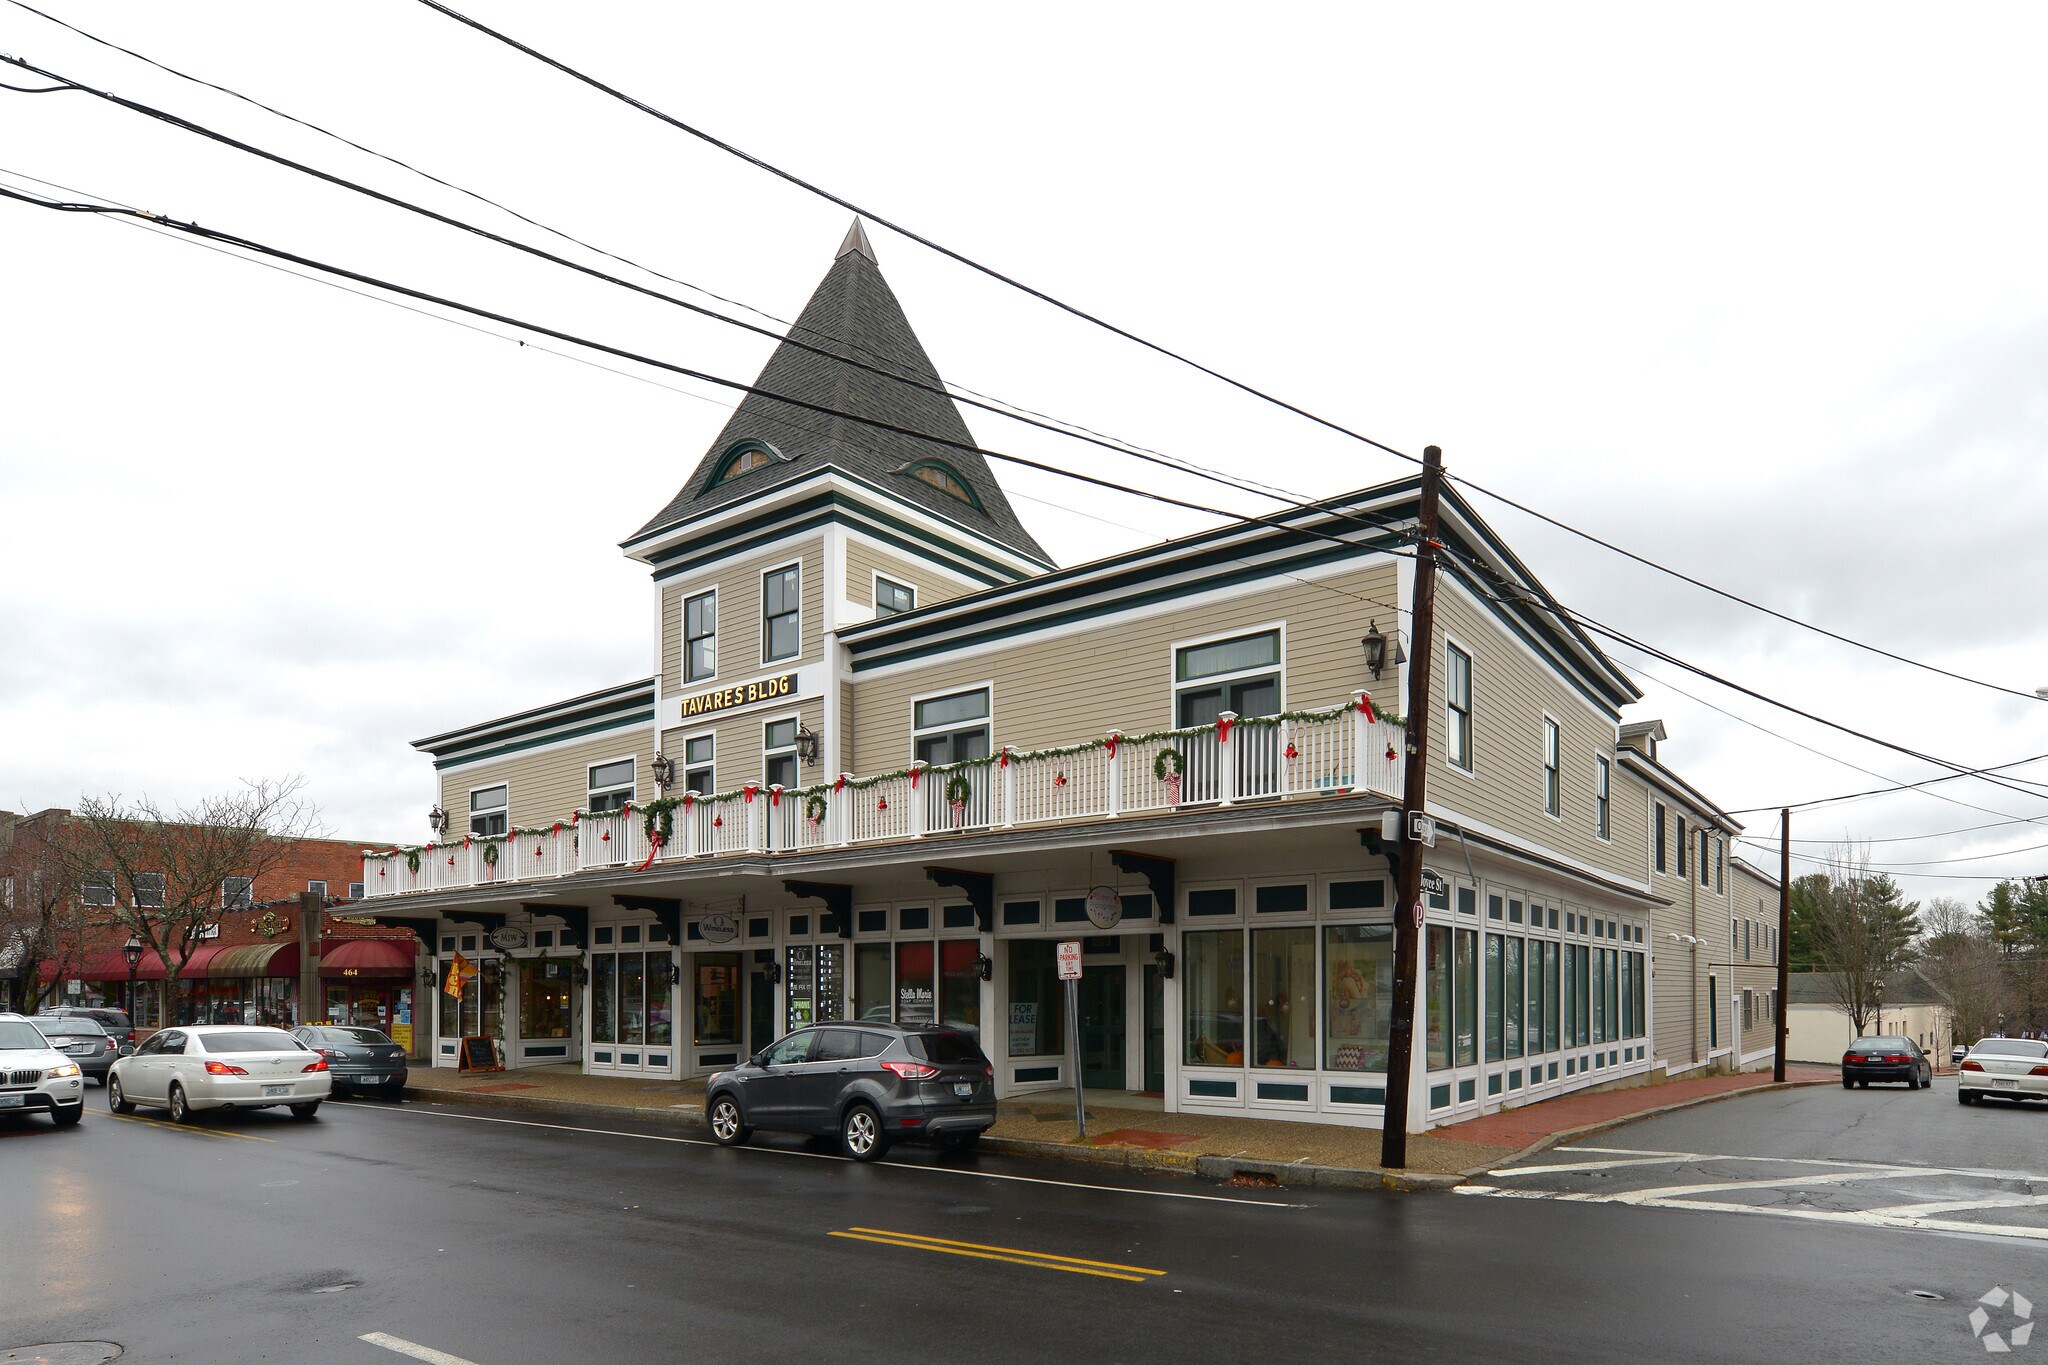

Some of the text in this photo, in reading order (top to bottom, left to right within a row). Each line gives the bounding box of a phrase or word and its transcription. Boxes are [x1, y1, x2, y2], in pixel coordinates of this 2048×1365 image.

[682, 675, 790, 716] TAVARES BLDG
[1421, 873, 1443, 892] Joyce St
[343, 969, 359, 977] 464
[901, 988, 932, 999] Stella Marie
[1014, 1004, 1032, 1014] FOR
[1009, 1014, 1036, 1024] LEASE
